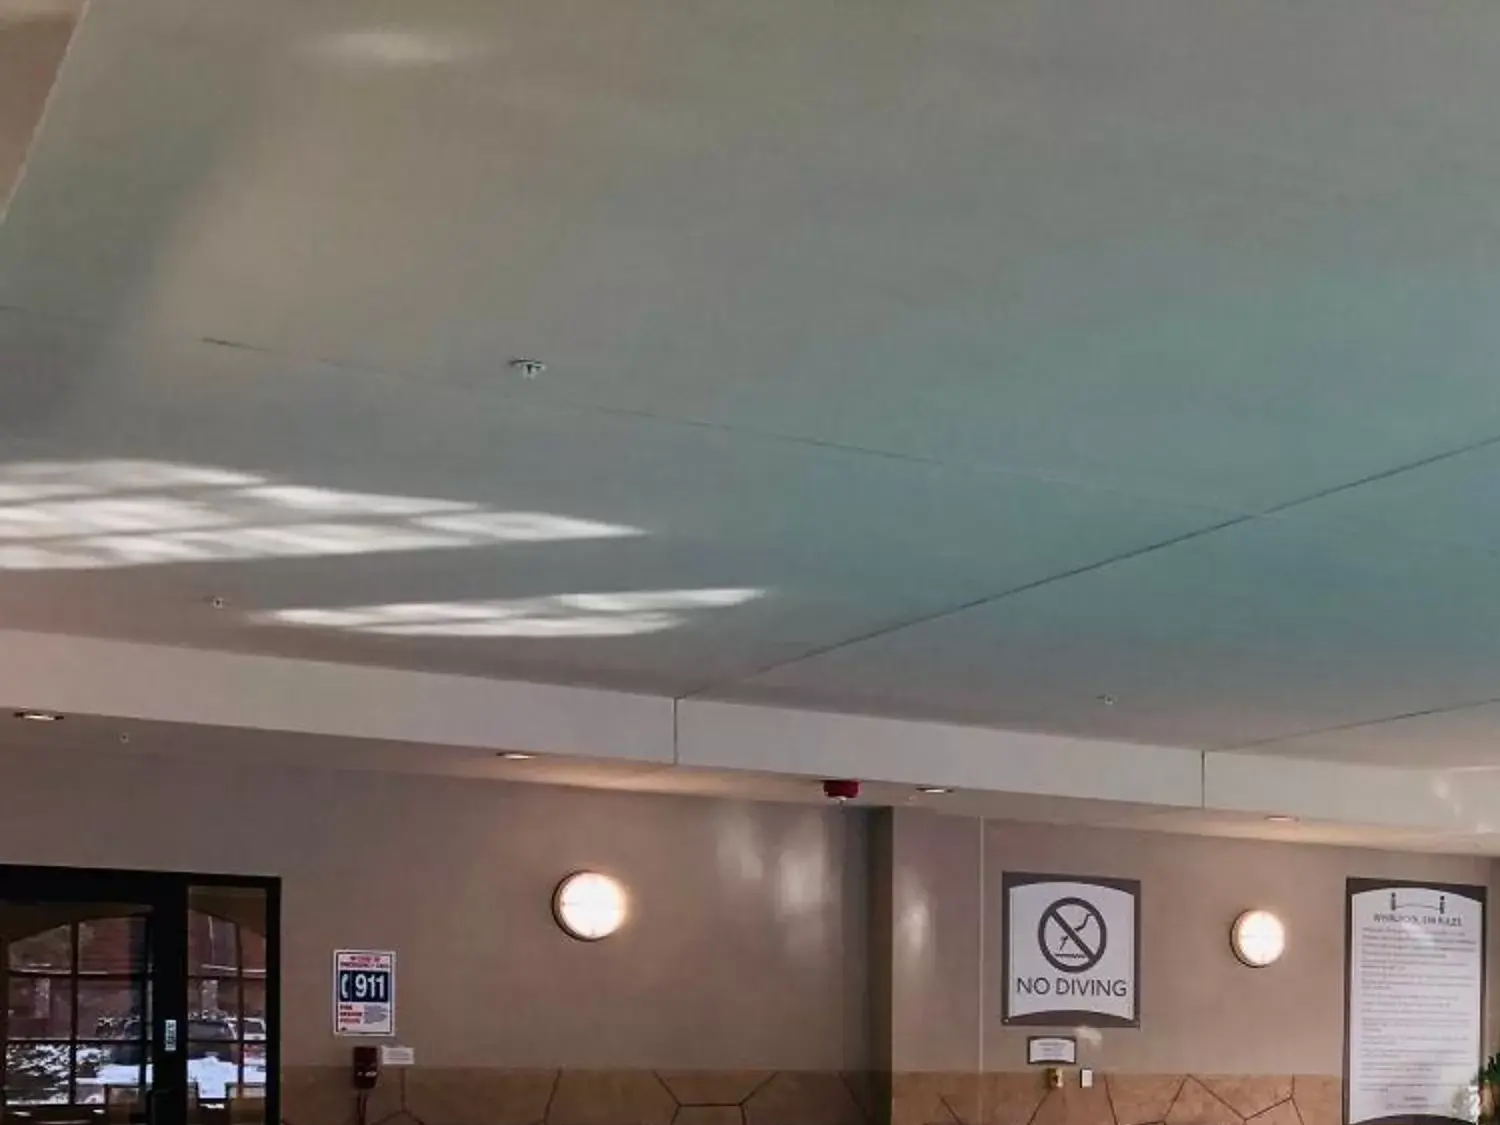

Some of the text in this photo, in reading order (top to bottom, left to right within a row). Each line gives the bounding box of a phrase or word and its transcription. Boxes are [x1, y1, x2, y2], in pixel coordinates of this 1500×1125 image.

[355, 973, 385, 998] 911
[1016, 976, 1127, 997] NO DIVING
